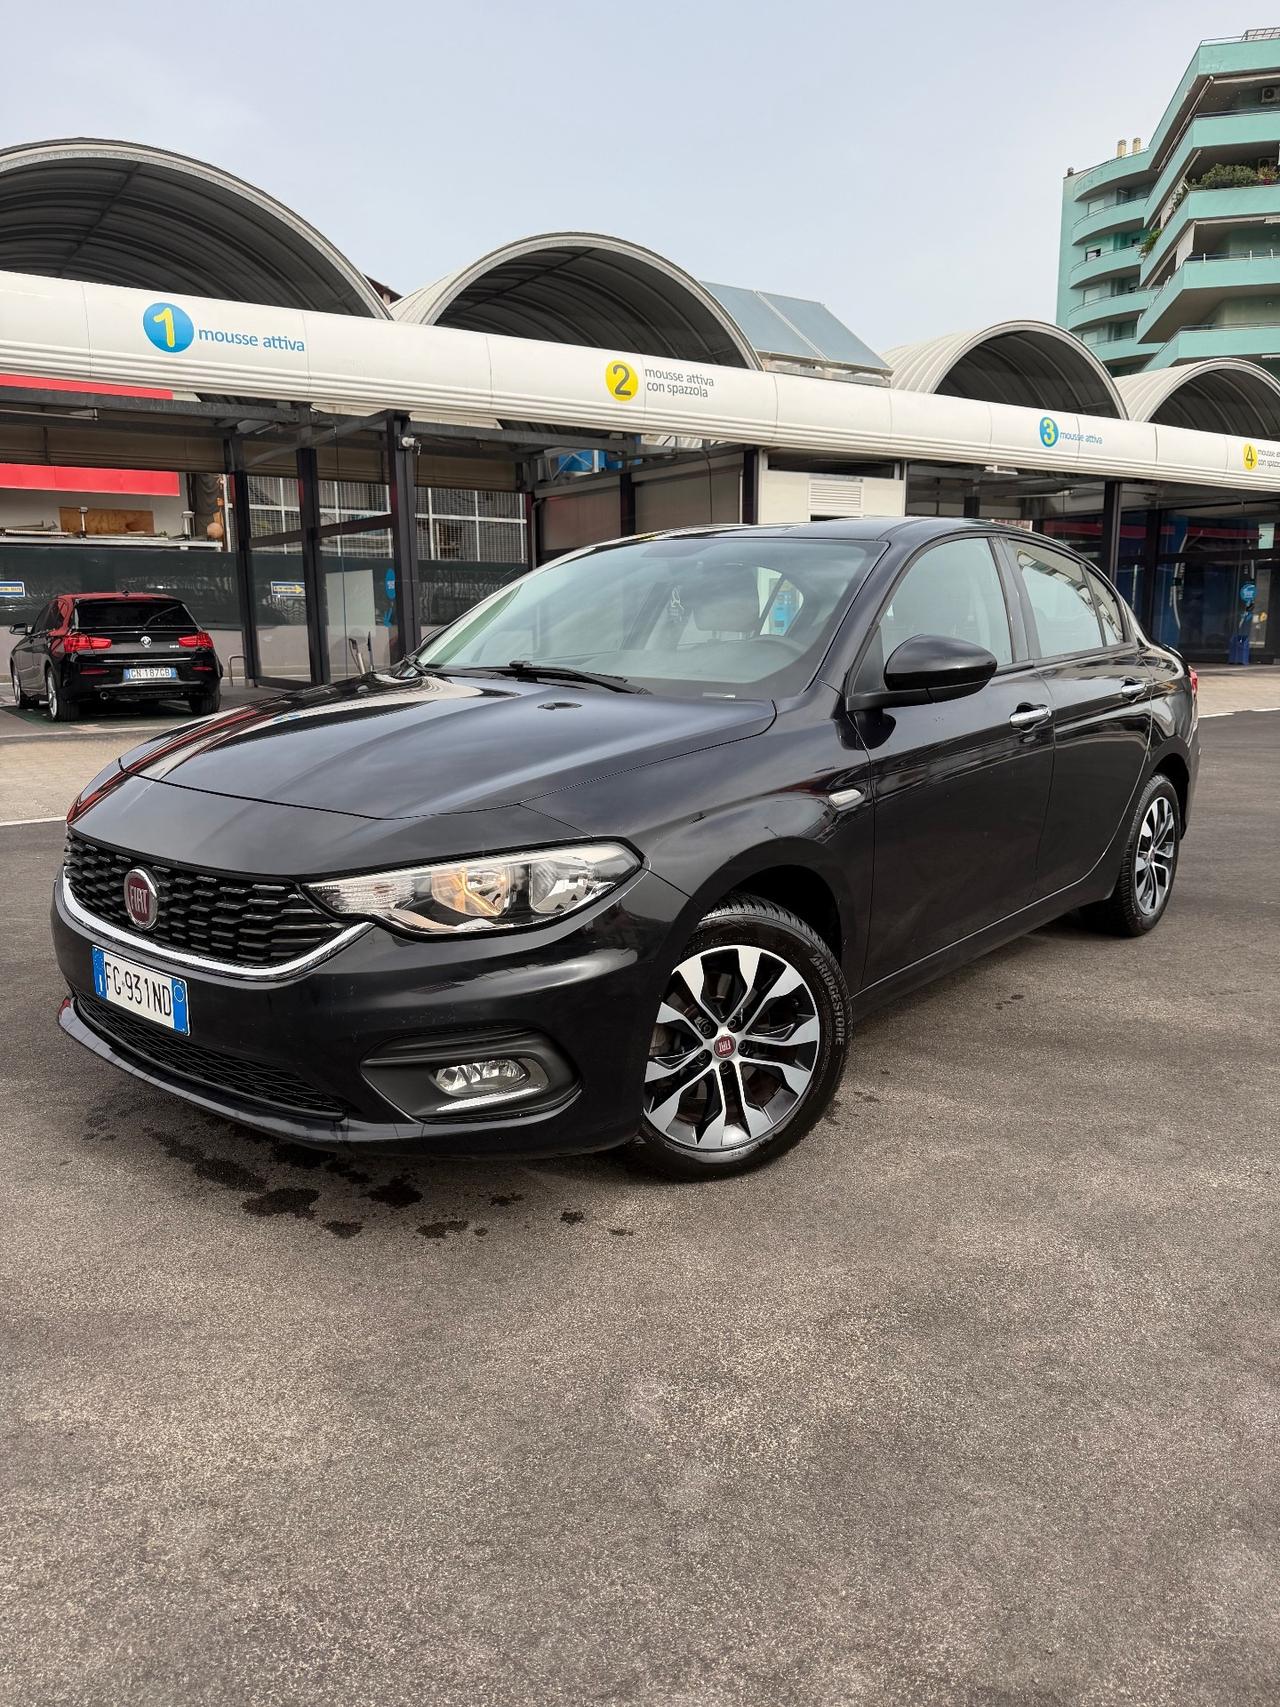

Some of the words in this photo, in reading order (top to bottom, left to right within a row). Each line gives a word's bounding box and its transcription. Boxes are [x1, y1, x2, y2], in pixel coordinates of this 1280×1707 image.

[153, 306, 175, 348] 1
[199, 328, 259, 347] mousse
[263, 335, 305, 352] attiva
[612, 364, 632, 396] 2
[645, 368, 684, 383] mousse
[686, 374, 715, 387] attiva
[647, 381, 665, 393] con
[667, 383, 709, 398] spazzola
[1043, 418, 1055, 445] 3
[1060, 432, 1084, 442] mousse
[1085, 433, 1104, 445] attiva
[1246, 446, 1255, 467] 4
[128, 885, 149, 914] FIAT
[809, 955, 846, 1046] BRIDGESTONE
[718, 1039, 732, 1053] FIAT
